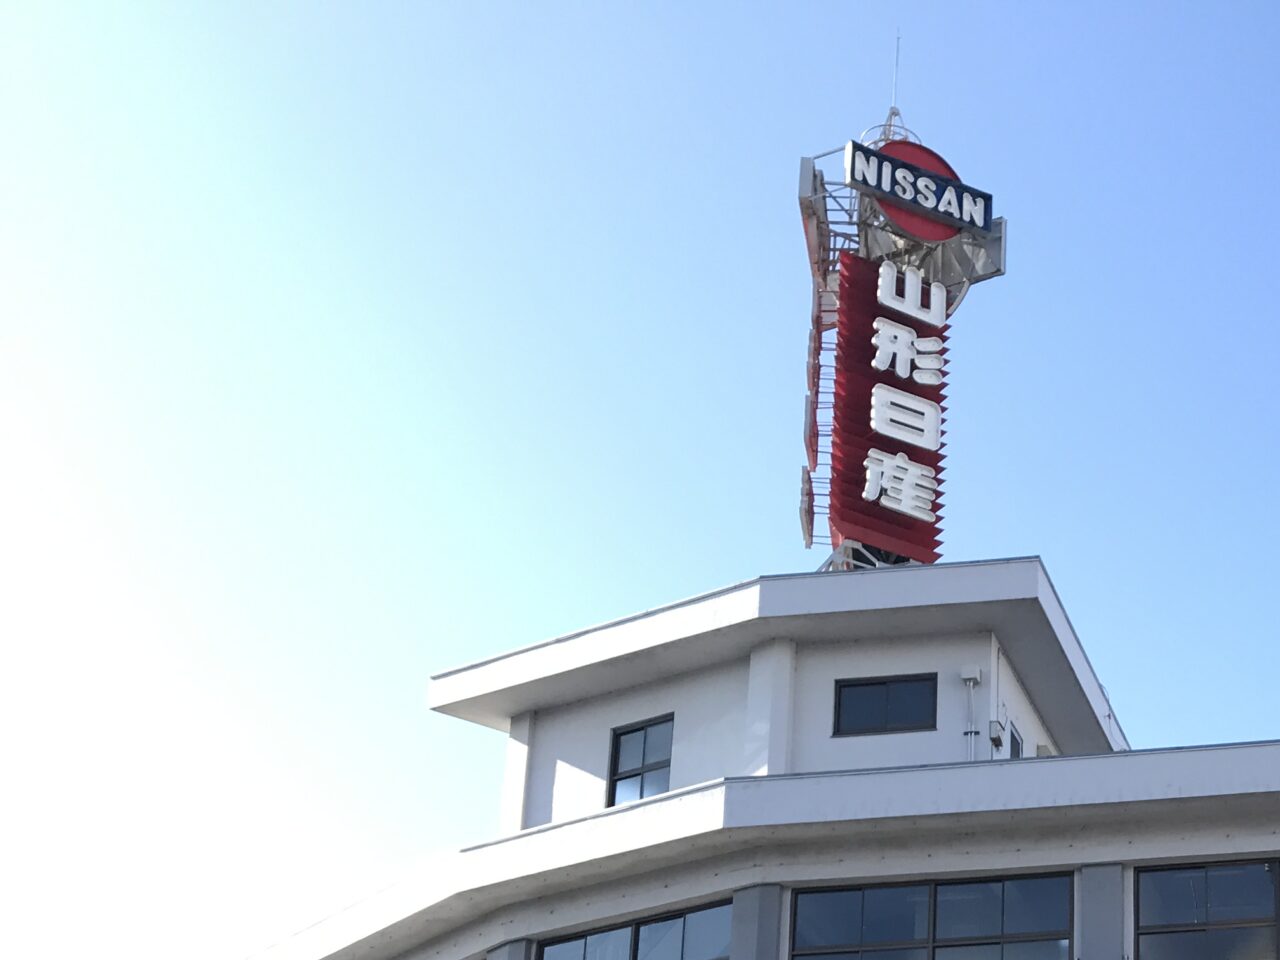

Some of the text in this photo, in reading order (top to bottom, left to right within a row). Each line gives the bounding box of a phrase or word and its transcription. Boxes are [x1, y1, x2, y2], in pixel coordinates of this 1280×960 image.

[853, 150, 985, 228] NISSAN
[861, 260, 947, 523] 山形日産
